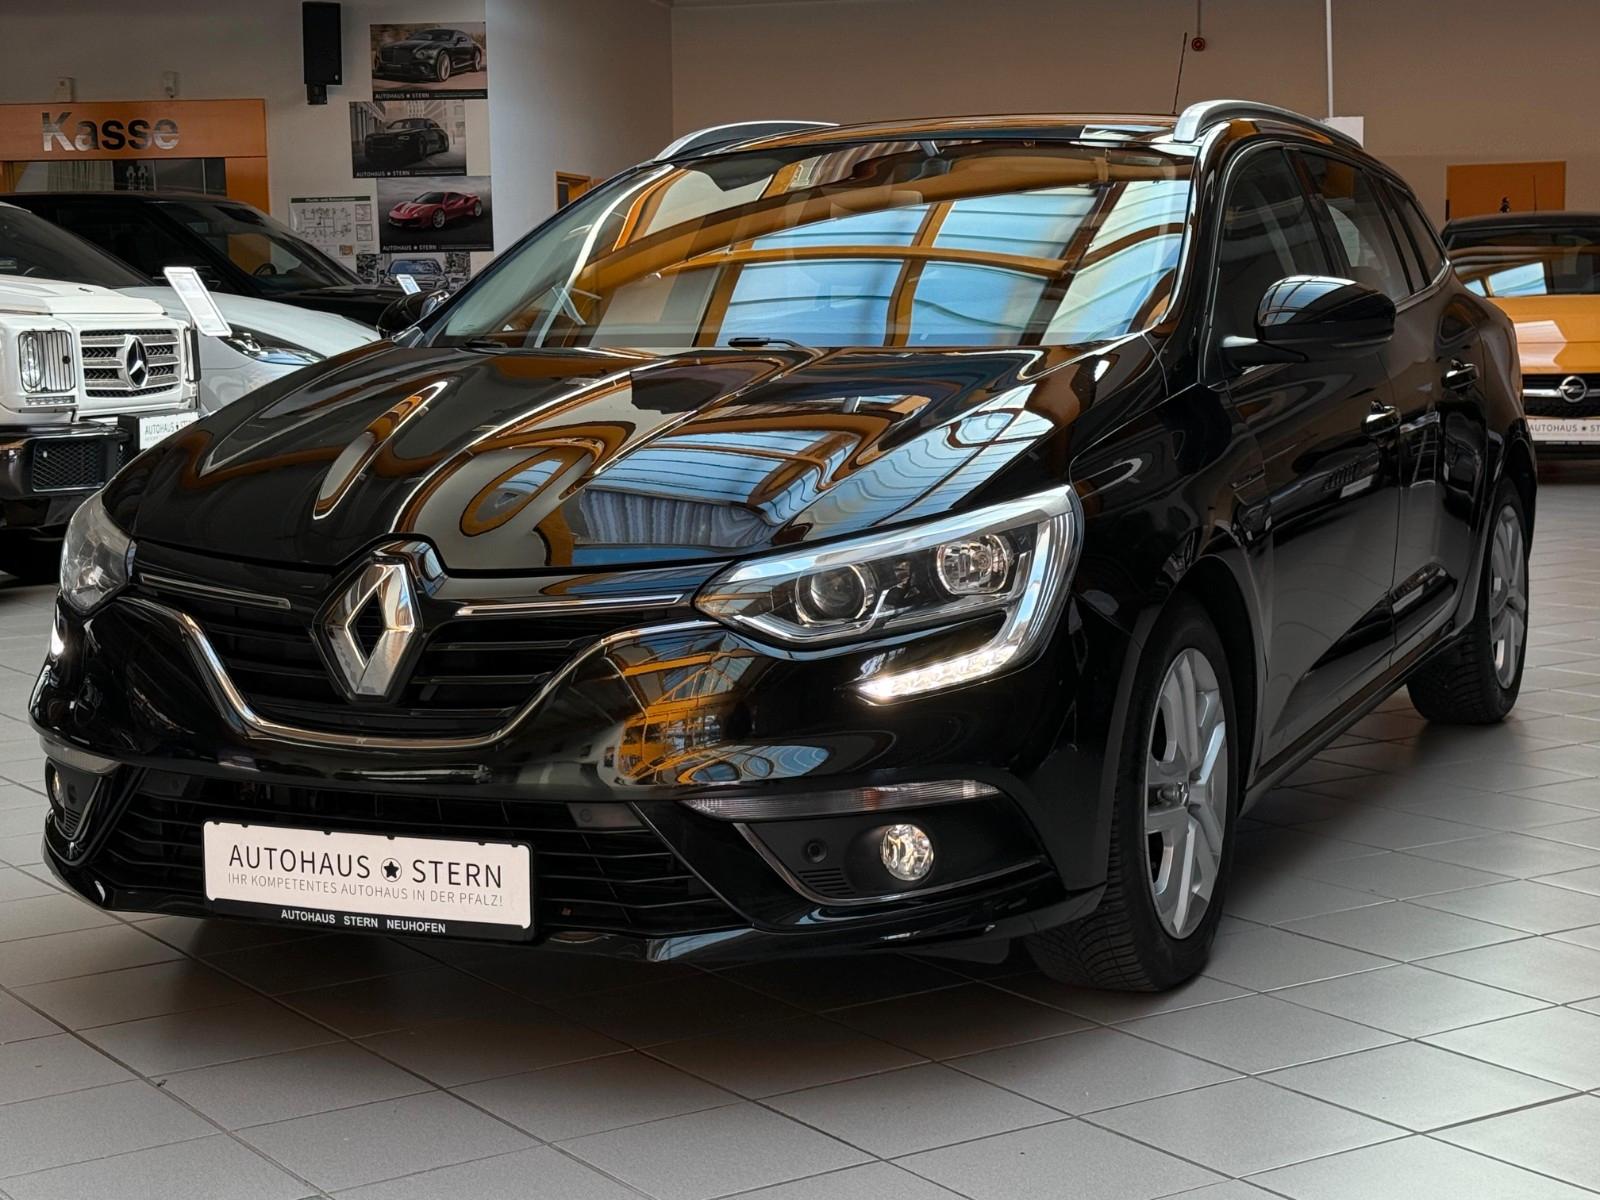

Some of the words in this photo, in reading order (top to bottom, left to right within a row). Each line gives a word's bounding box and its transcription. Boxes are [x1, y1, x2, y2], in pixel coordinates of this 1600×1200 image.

[42, 112, 179, 151] Kasse
[229, 845, 370, 878] AUTOHAUS
[412, 859, 501, 888] STERN
[228, 872, 247, 885] IHR
[251, 875, 337, 894] KOMPETENTES
[341, 883, 408, 900] AUTOHAUS
[412, 889, 425, 901] IN
[430, 890, 455, 903] DER
[460, 892, 503, 907] PFALZ!
[281, 909, 336, 924] AUTOHAUS
[344, 915, 378, 928] STERN
[386, 919, 446, 933] NEUHOFEN
